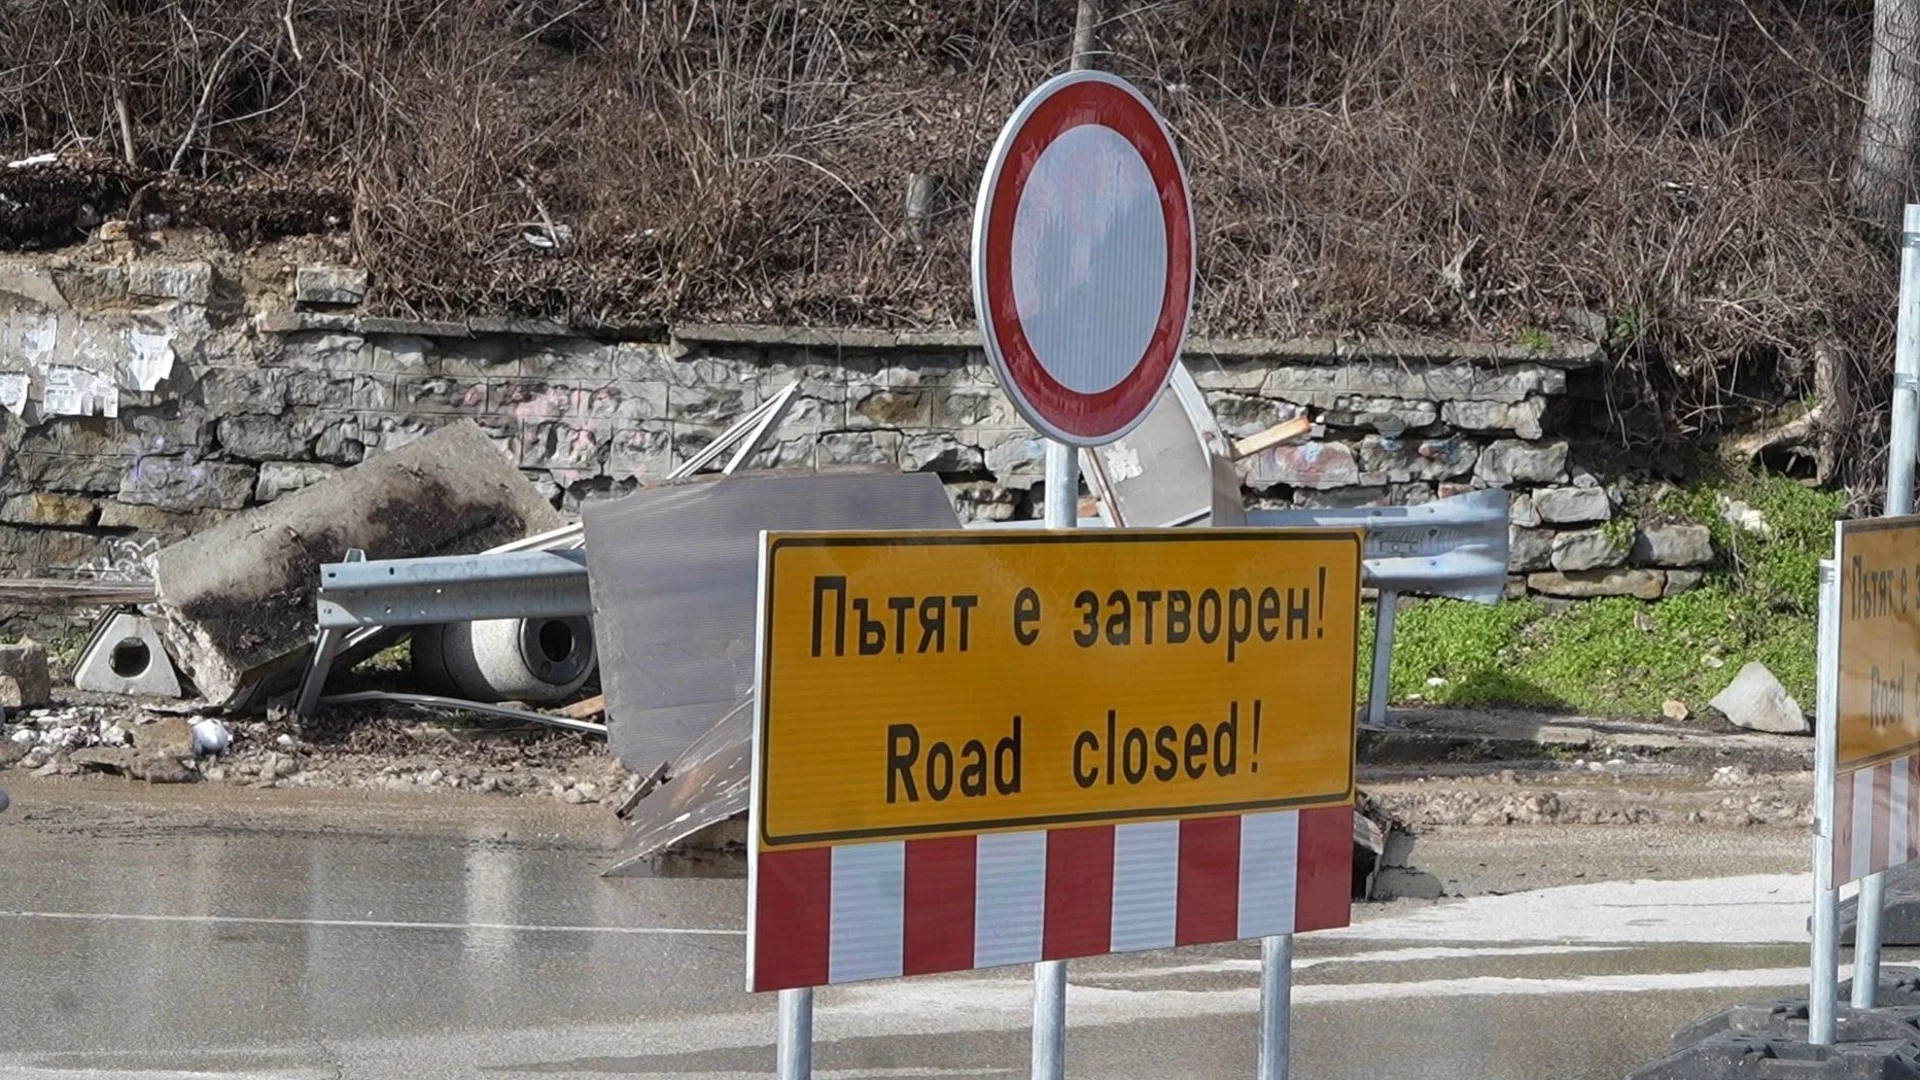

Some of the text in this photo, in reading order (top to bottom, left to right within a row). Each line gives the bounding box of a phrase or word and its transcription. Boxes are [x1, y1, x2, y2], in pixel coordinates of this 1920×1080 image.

[812, 567, 1327, 663] Пътят е затворен!
[1851, 555, 1893, 620] Пътят
[1870, 659, 1905, 729] Road
[886, 700, 1262, 804] Road closed!
